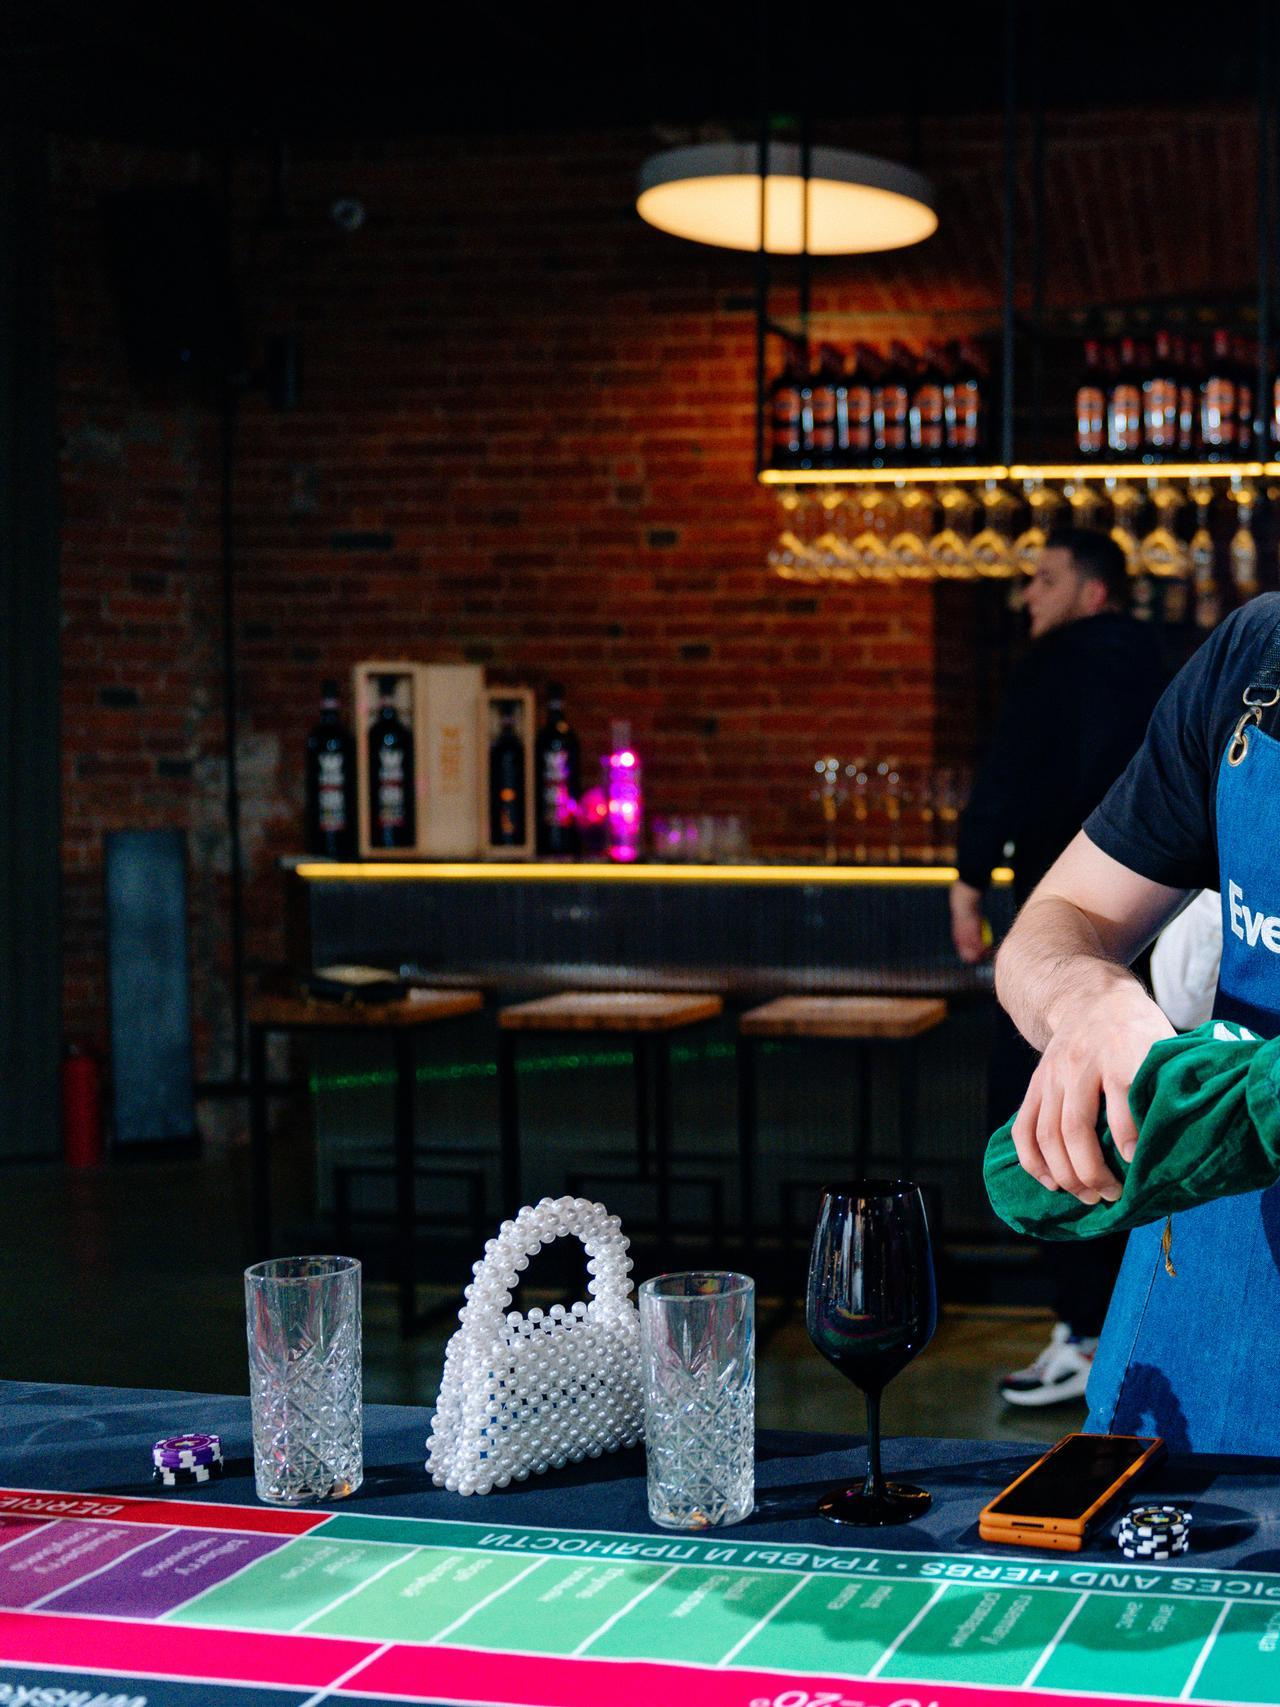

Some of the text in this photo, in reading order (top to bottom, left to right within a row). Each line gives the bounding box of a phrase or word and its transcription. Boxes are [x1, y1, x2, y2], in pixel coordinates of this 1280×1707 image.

[477, 1532, 698, 1561] ПРЯНОСТИ
[704, 1547, 738, 1562] И
[743, 1551, 880, 1573] ТРАВЫ
[921, 1561, 1059, 1583] HERBS
[1070, 1572, 1161, 1590] AND
[980, 1595, 1032, 1644] rosemary
[1150, 1605, 1175, 1631] anise
